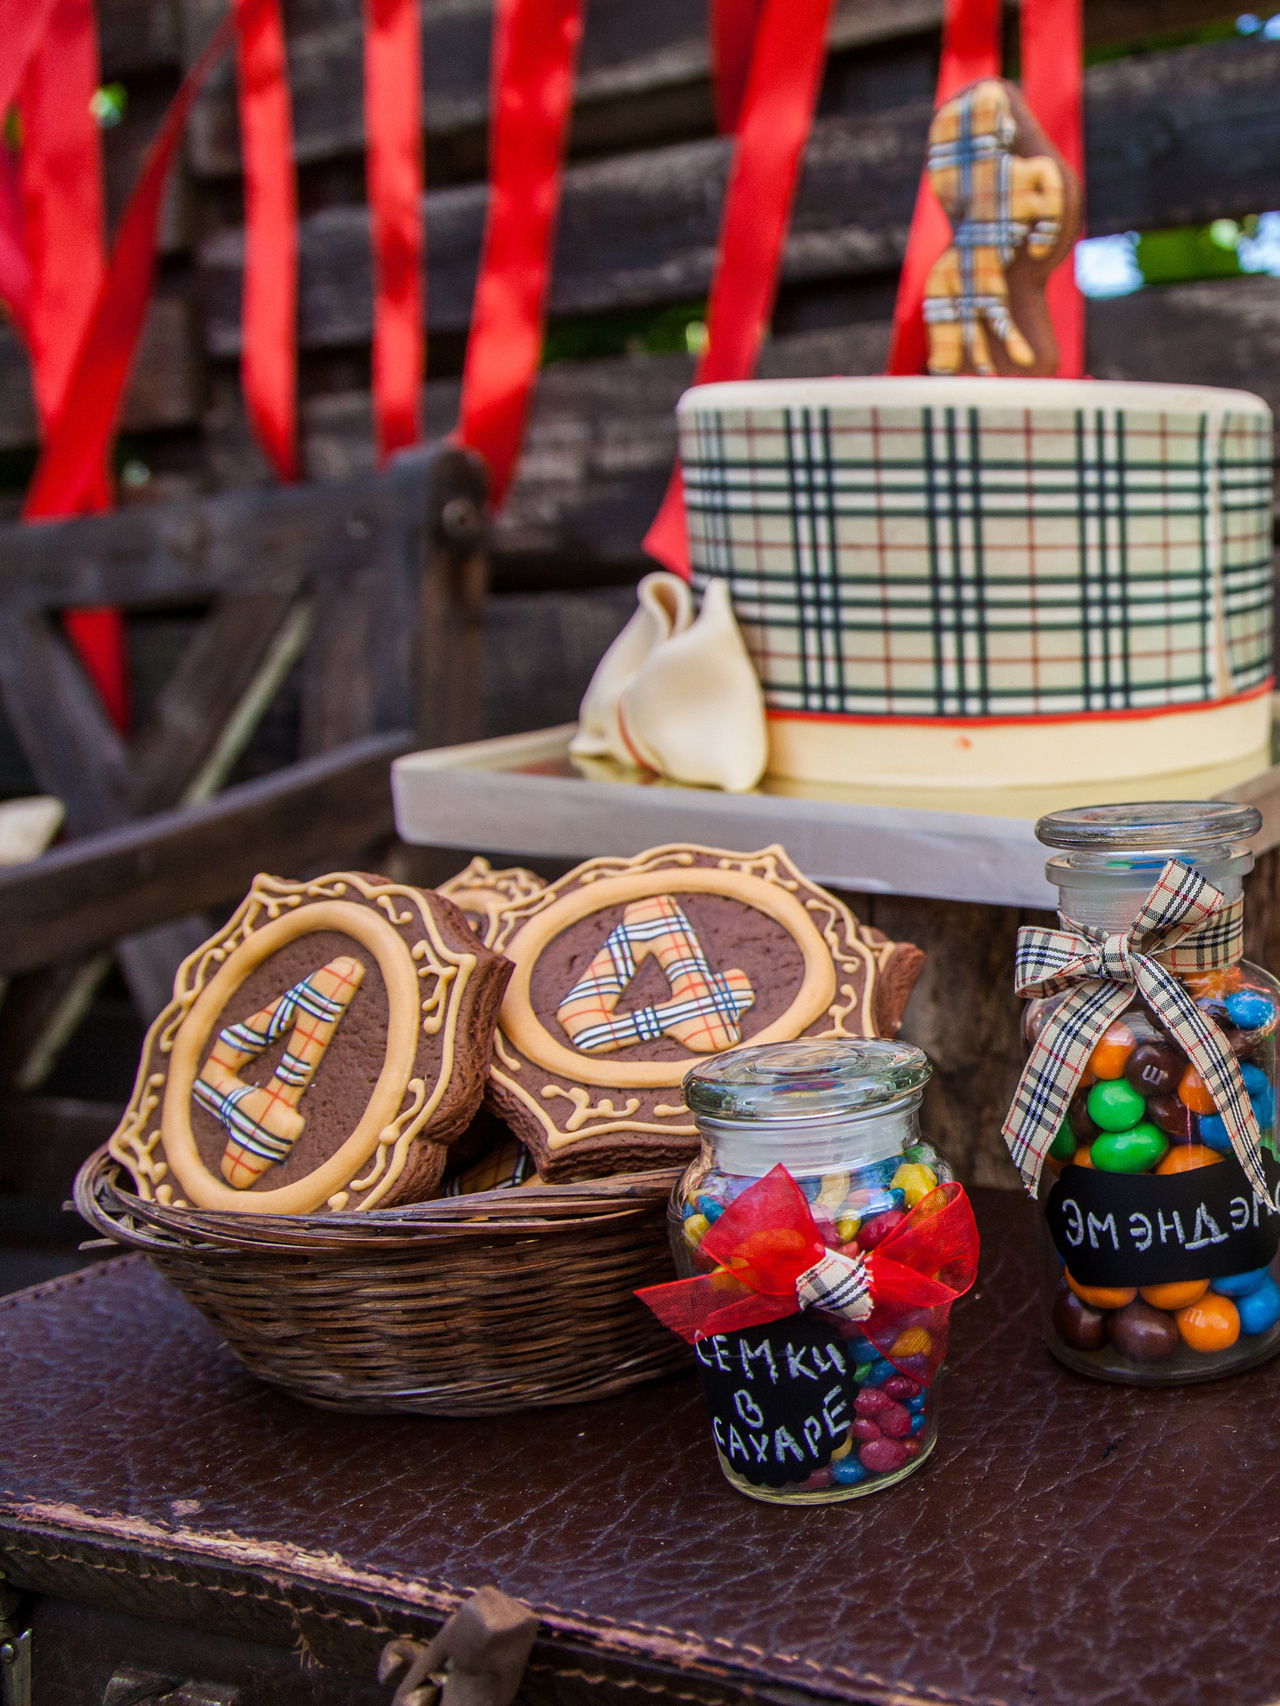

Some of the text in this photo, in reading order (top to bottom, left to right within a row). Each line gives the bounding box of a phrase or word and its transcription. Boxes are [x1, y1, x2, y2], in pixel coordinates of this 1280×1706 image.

[695, 1329, 847, 1385] СЕМКИ
[712, 1385, 851, 1463] САХАРЕ
[733, 1389, 764, 1429] В
